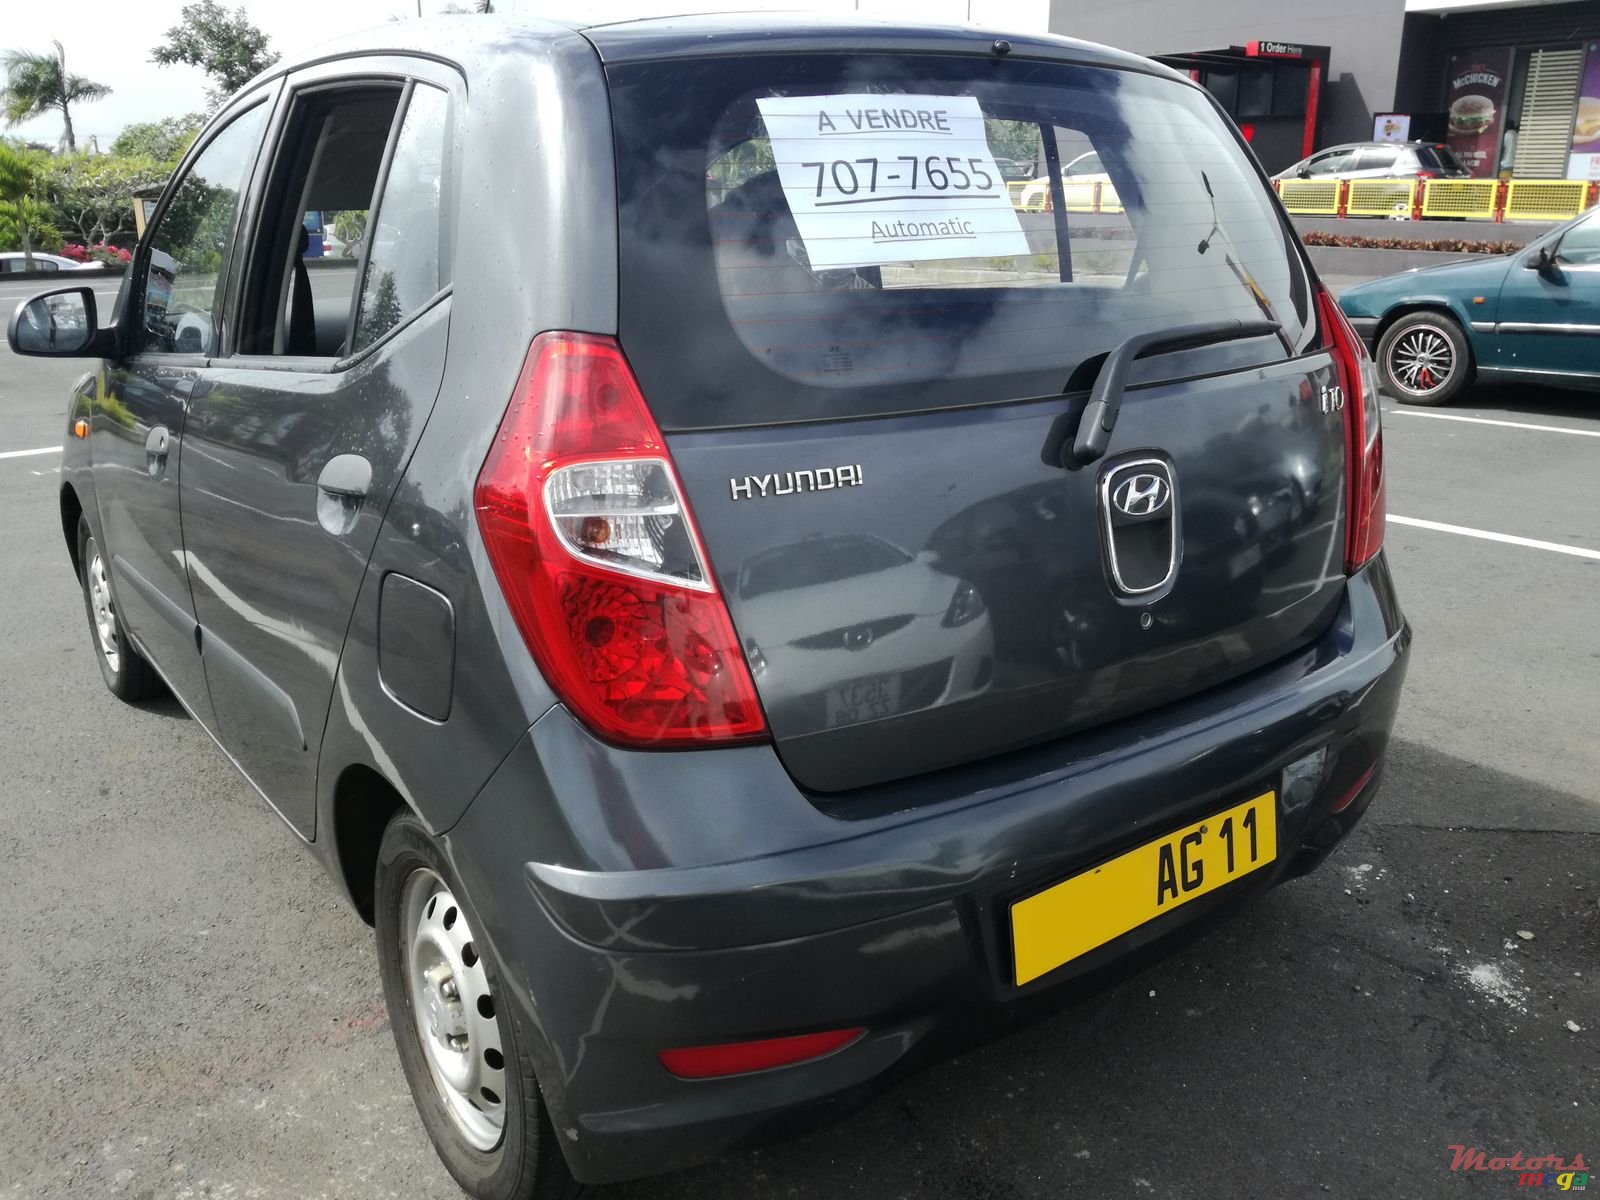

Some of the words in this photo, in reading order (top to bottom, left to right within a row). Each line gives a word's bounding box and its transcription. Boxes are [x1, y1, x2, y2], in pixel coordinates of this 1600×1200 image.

[1260, 42, 1265, 52] 1
[1266, 42, 1287, 53] Order
[1287, 44, 1303, 55] Here
[818, 110, 837, 132] A
[846, 109, 951, 132] VENDRE
[801, 156, 994, 198] 707-7655
[871, 217, 974, 239] Automatic
[1321, 385, 1345, 414] i10
[729, 464, 864, 500] HYUNDAI
[1157, 830, 1204, 906] AG
[1219, 806, 1258, 874] 11
